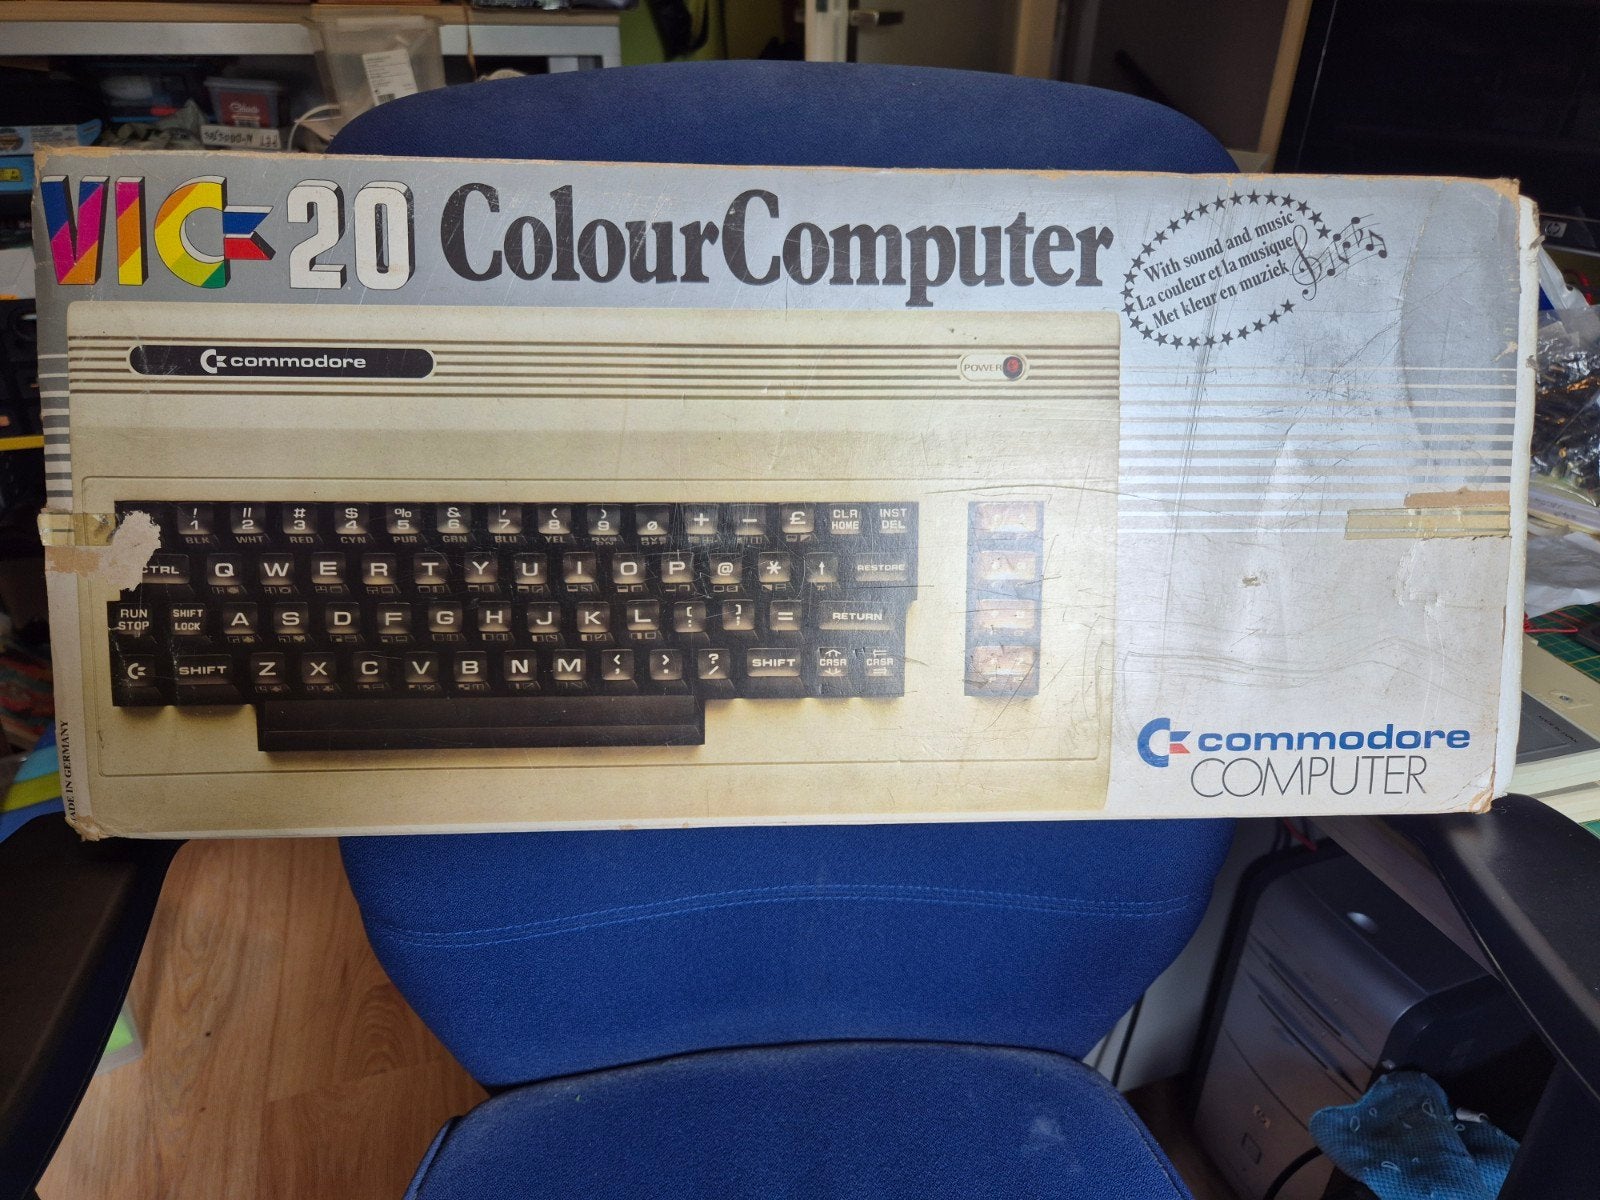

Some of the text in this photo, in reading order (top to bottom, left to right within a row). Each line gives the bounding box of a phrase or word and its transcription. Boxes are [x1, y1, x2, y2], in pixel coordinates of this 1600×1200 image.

[1143, 210, 1295, 283] With sound and music
[1135, 236, 1294, 312] La couleur et la musique
[1152, 259, 1290, 329] Met kleur en muziek
[230, 354, 367, 370] commodore
[964, 364, 1003, 372] POWER
[344, 508, 358, 519] $
[447, 507, 462, 518] &
[790, 511, 806, 525] £
[833, 509, 858, 519] CLR
[879, 508, 908, 518] INST
[190, 520, 199, 530] 1
[242, 520, 254, 530] 2
[293, 520, 306, 530] 3
[344, 520, 358, 530] 4
[397, 520, 410, 530] 5
[448, 519, 460, 530] 6
[498, 519, 510, 530] 7
[548, 520, 560, 530] 8
[598, 520, 610, 531] 9
[831, 520, 860, 530] HOME
[882, 520, 906, 530] DEL
[185, 536, 566, 544] BLK WHT RED CYN PUR GRN BLU YEL
[214, 562, 235, 577] Q
[263, 562, 290, 577] W
[319, 561, 338, 576] E
[370, 562, 388, 576] R
[421, 562, 439, 576] T
[472, 561, 490, 575] Y
[522, 562, 539, 576] U
[620, 562, 638, 576] O
[668, 561, 686, 575] P
[717, 562, 734, 576] @
[856, 563, 906, 572] RESTORE
[120, 608, 148, 619] RUN
[172, 608, 204, 618] SHIFT
[230, 612, 250, 626] A
[282, 612, 300, 626] S
[334, 612, 352, 626] D
[385, 612, 403, 626] F
[436, 610, 454, 625] G
[486, 610, 503, 624] H
[536, 611, 553, 625] J
[584, 611, 602, 624] K
[634, 609, 652, 623] L
[832, 612, 883, 621] RETURN
[118, 620, 150, 631] STOP
[174, 622, 201, 631] LOCK
[178, 665, 228, 675] SHIFT
[258, 662, 276, 676] Z
[310, 661, 328, 676] X
[361, 660, 378, 675] C
[412, 660, 430, 675] V
[462, 660, 479, 674] B
[511, 659, 528, 674] N
[558, 658, 582, 672] M
[752, 658, 796, 667] SHIFT
[1198, 723, 1471, 752] commodore
[60, 720, 73, 778] GERMANY
[1191, 755, 1427, 798] COMPUTER
[65, 780, 74, 793] IN
